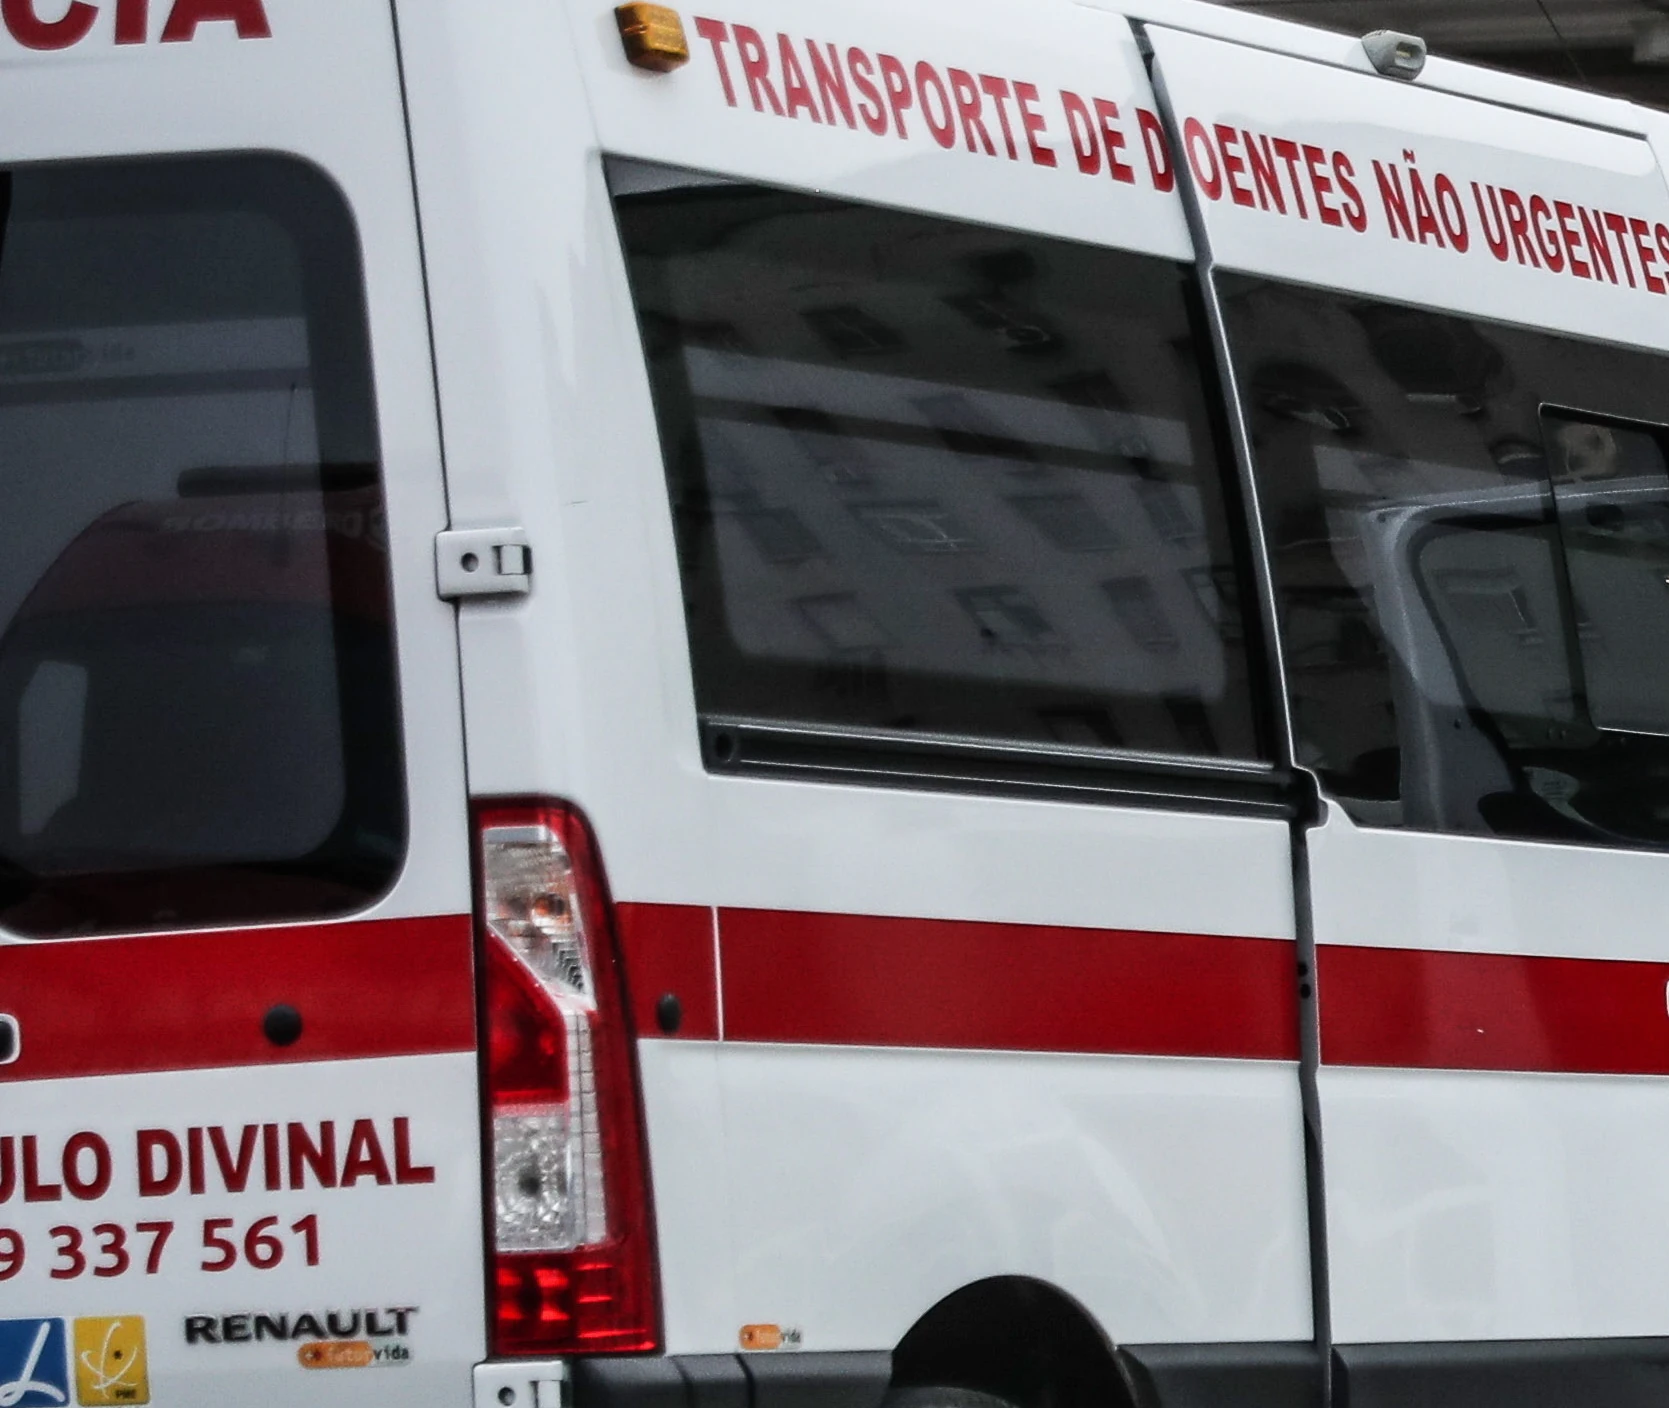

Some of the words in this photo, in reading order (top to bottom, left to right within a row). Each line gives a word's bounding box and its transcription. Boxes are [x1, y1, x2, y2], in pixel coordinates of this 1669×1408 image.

[694, 15, 1058, 169] TRANSPORTE
[1058, 89, 1136, 185] DE
[1135, 107, 1368, 233] DOENTES
[1371, 149, 1470, 254] NÃO
[137, 1116, 435, 1198] DIVINAL
[49, 1220, 175, 1280] 337
[200, 1214, 320, 1272] 561
[184, 1306, 420, 1344] RENAULT
